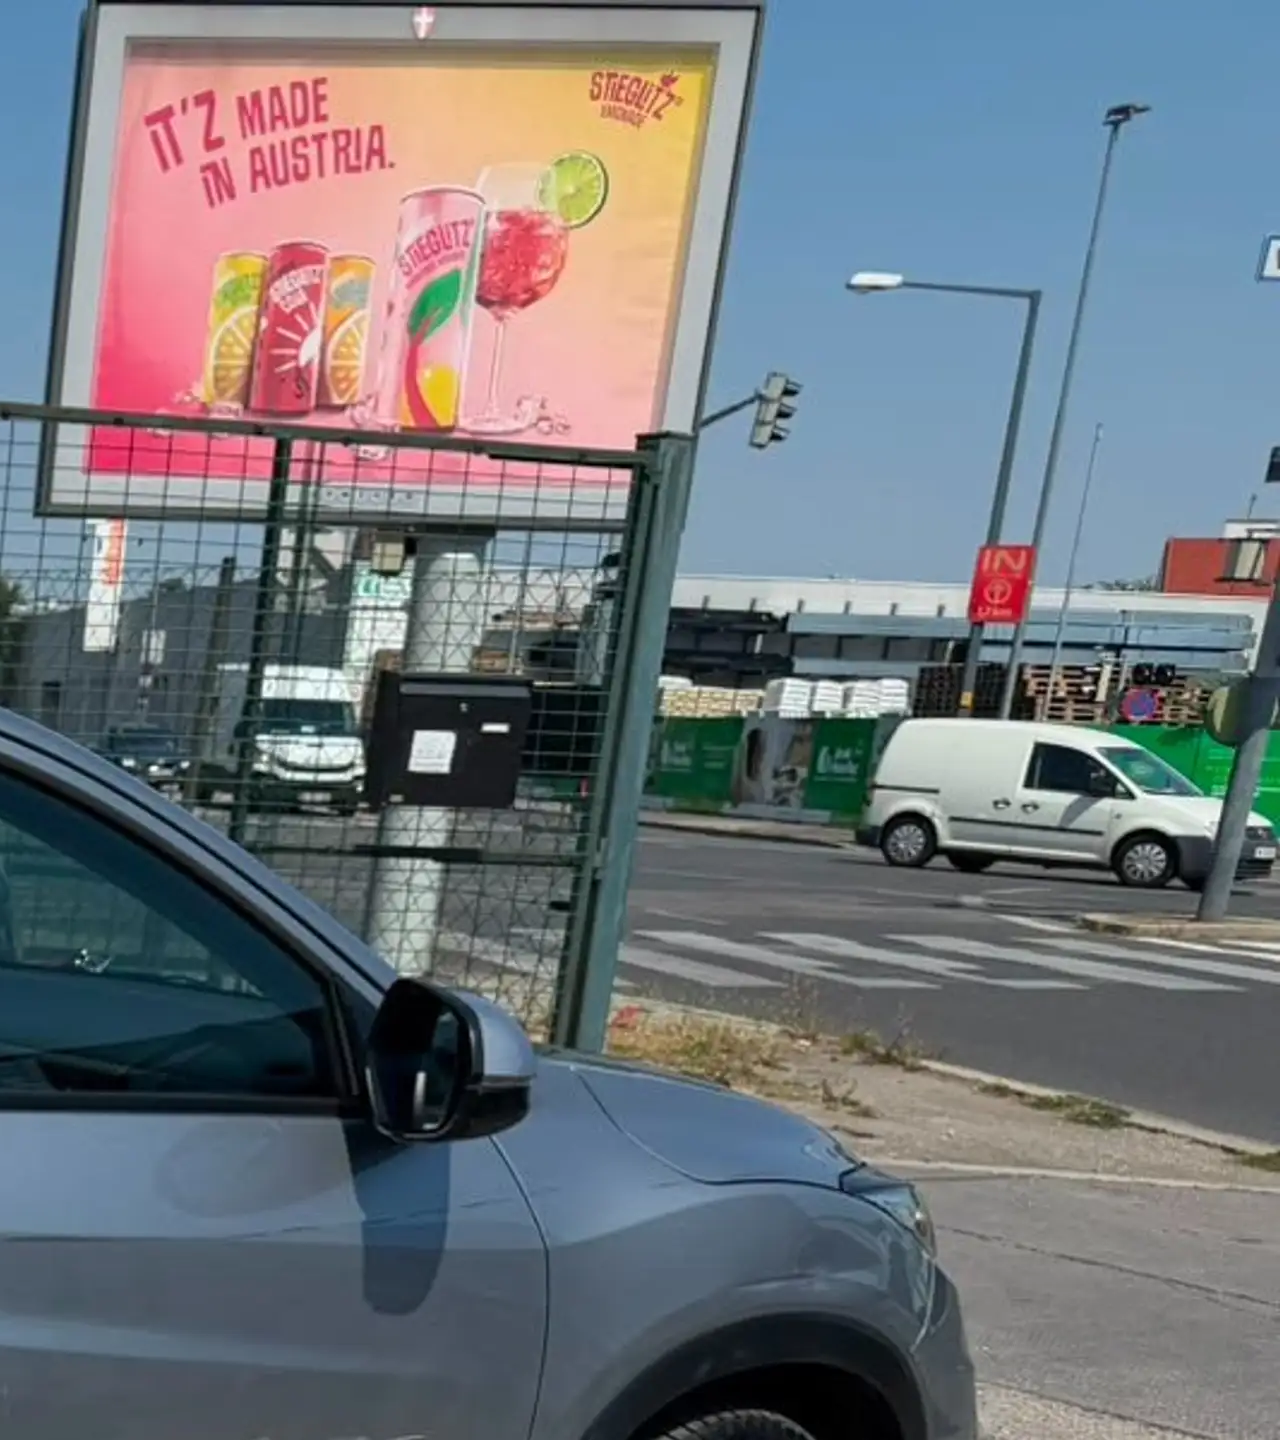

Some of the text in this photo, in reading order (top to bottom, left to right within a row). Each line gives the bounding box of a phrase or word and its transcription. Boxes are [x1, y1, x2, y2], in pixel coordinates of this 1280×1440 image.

[236, 77, 329, 140] MADE
[200, 124, 396, 209] IN AUSTRIA.
